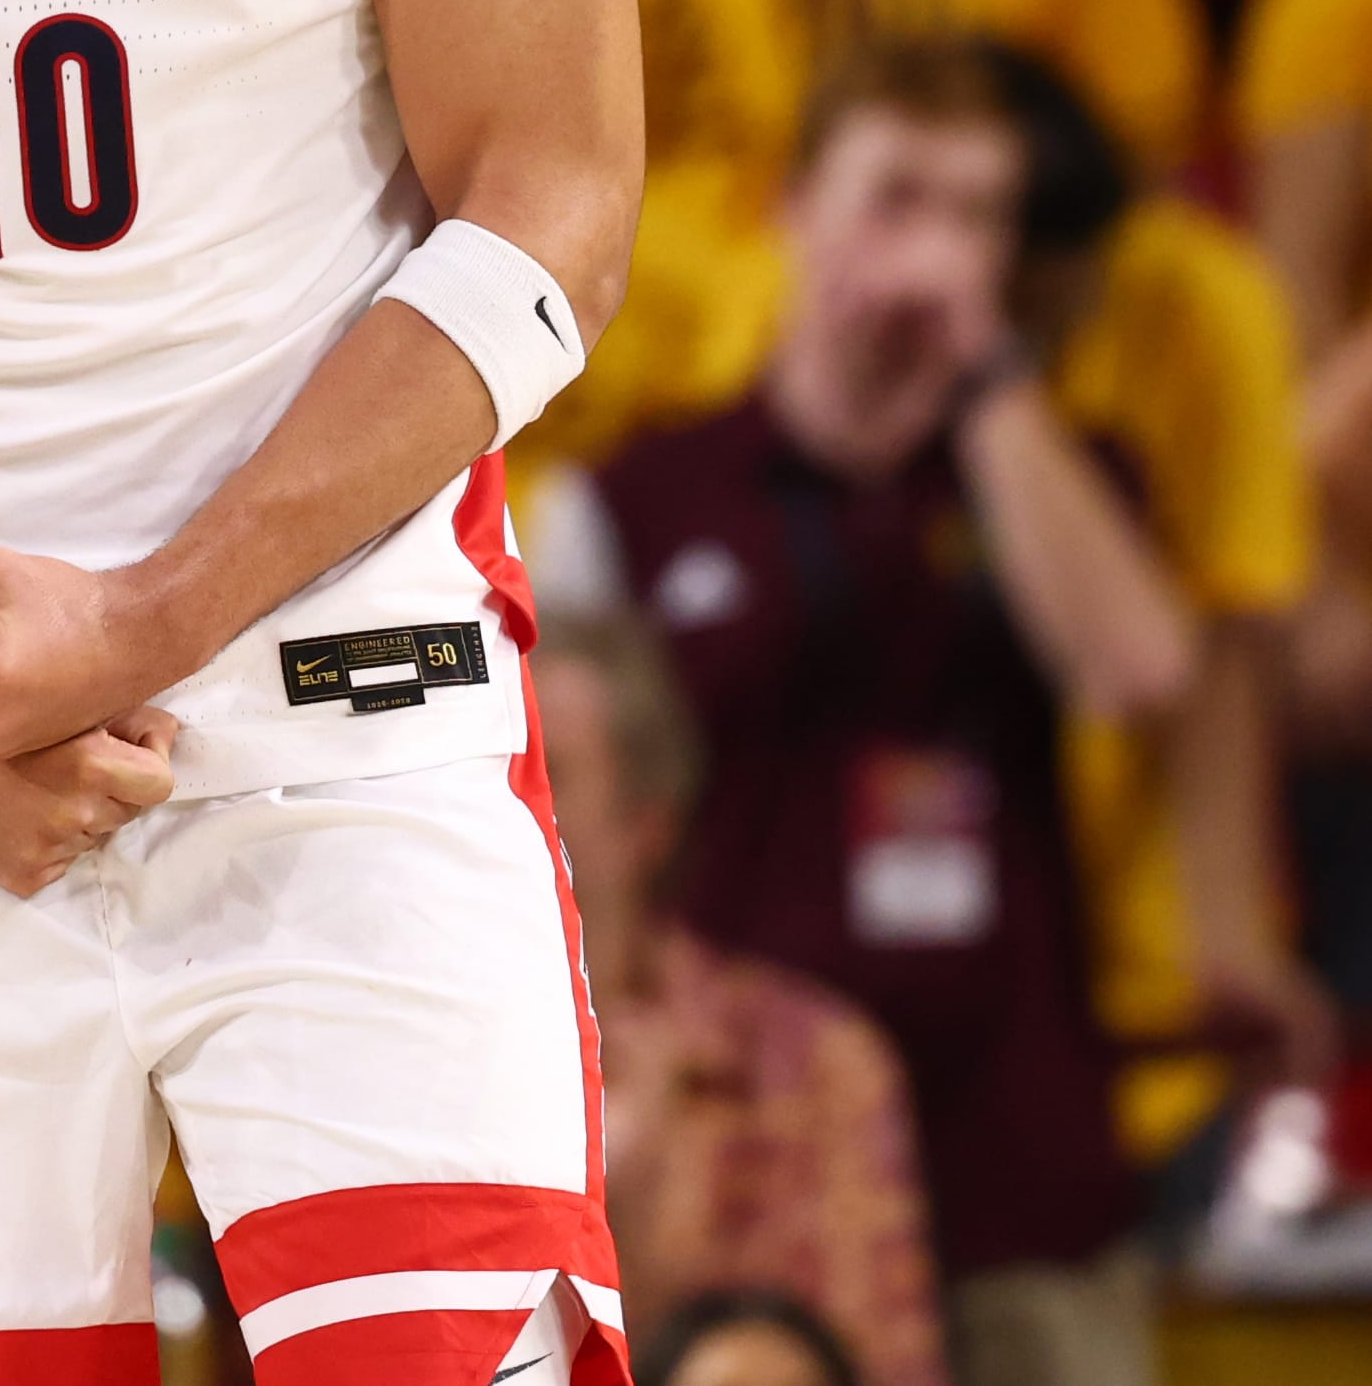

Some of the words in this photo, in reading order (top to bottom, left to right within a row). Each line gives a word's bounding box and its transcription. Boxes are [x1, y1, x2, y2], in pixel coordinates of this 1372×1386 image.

[344, 636, 410, 652] ENGINEERED
[427, 642, 457, 667] 50
[298, 670, 339, 686] ELITE
